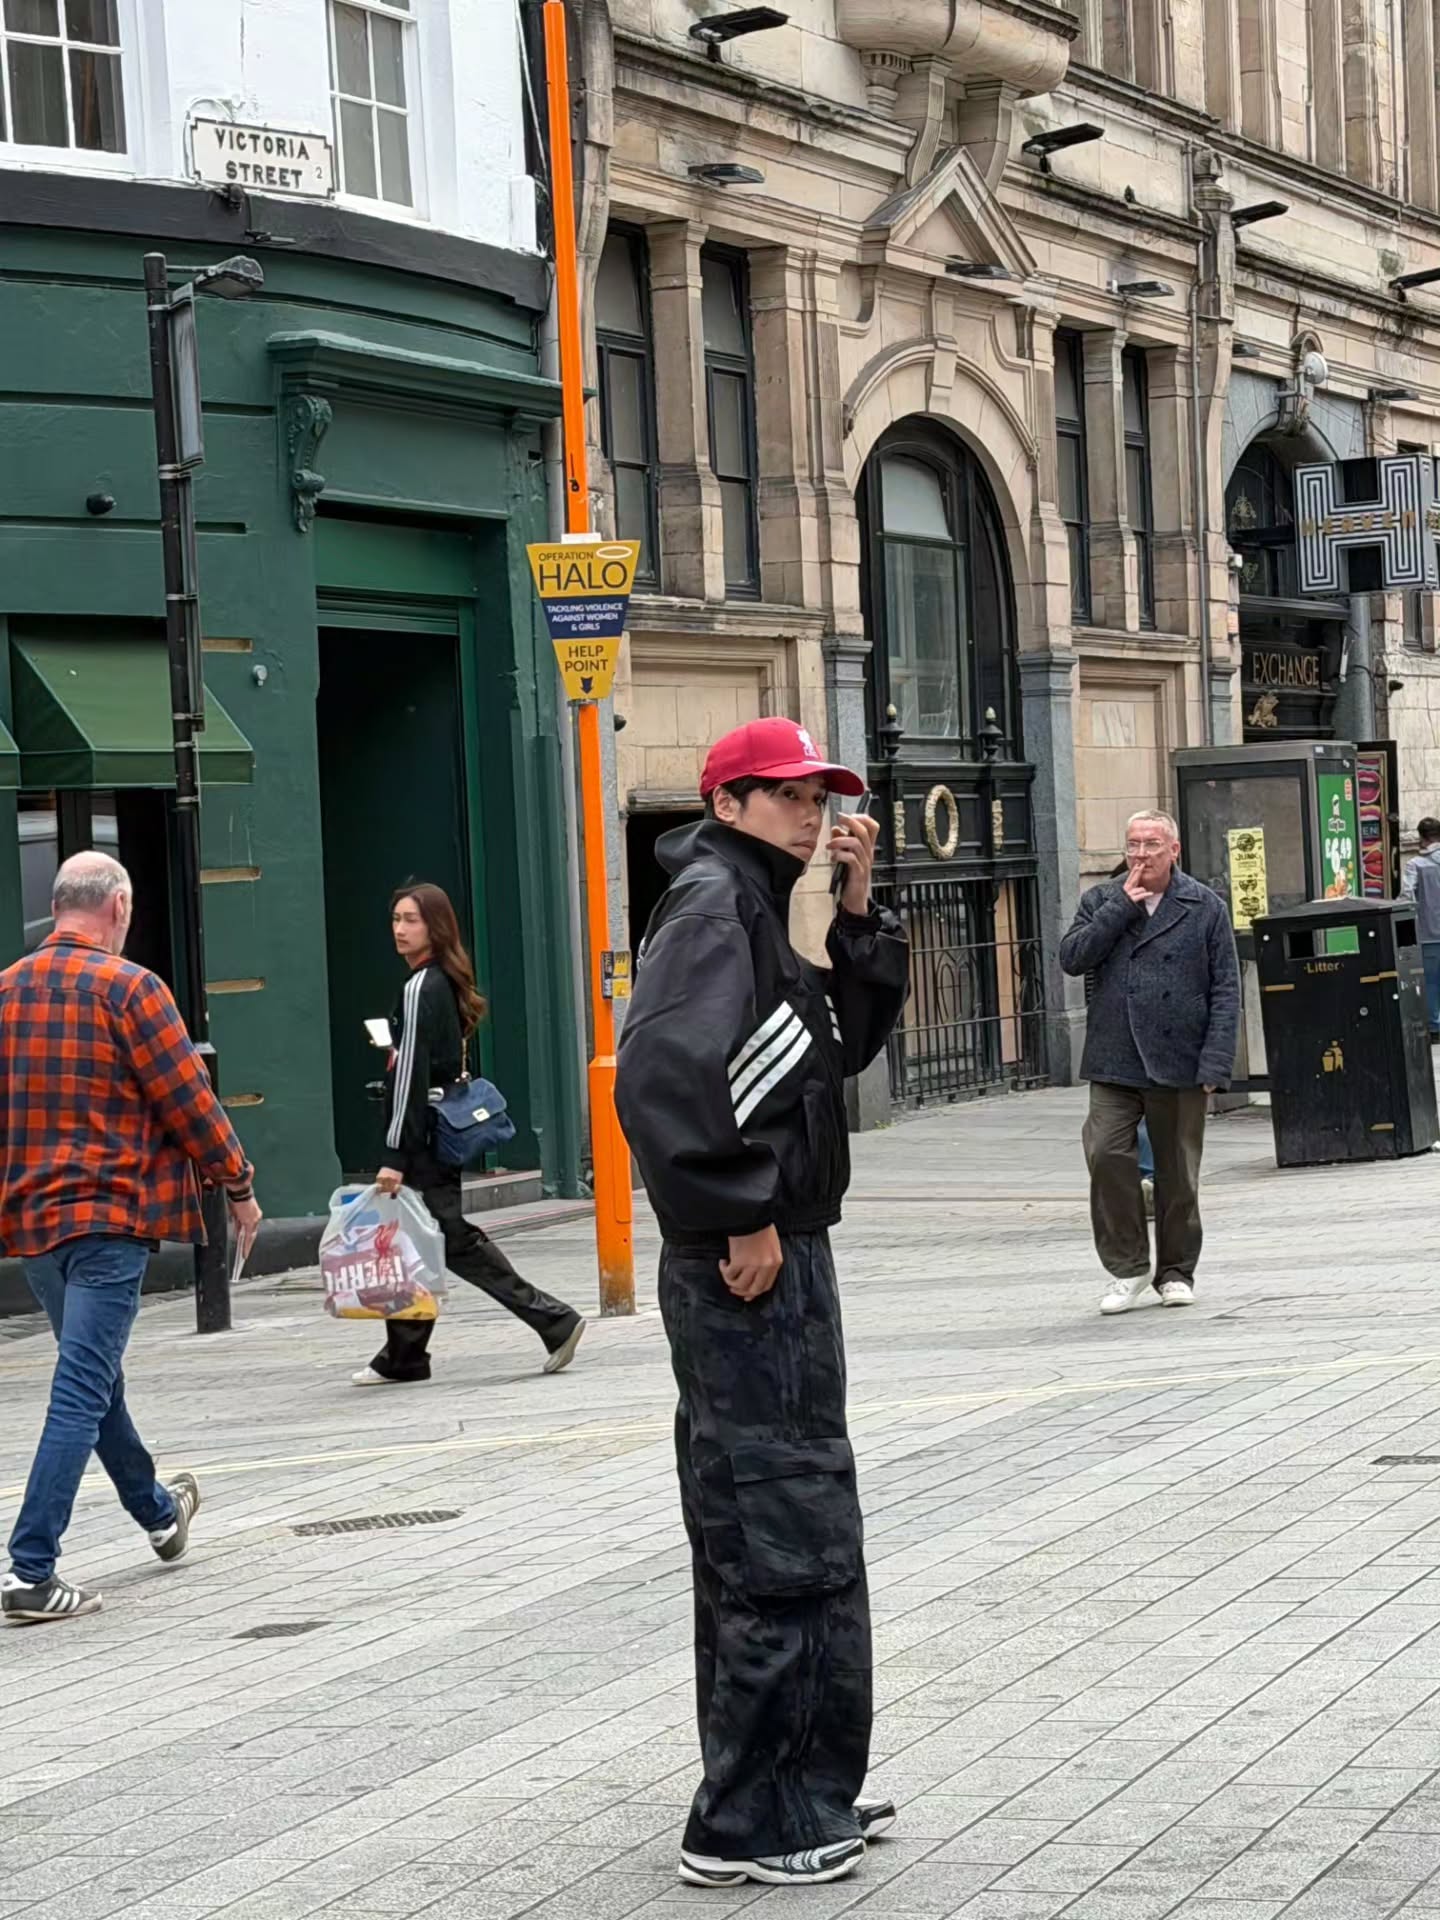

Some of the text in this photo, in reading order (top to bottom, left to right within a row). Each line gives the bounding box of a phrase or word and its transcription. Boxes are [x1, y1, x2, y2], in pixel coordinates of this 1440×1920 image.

[214, 127, 310, 161] VICTORIA
[225, 160, 323, 189] STREET 2
[538, 551, 594, 562] OPERATION
[539, 561, 628, 592] HALO
[546, 602, 623, 613] TACKLING VIOLENCE
[551, 612, 619, 623] AGAINST WOMEN
[571, 622, 600, 632] & GIRLS
[568, 645, 604, 658] HELP
[564, 659, 609, 673] POINT
[1252, 651, 1320, 687] EXCHANGE
[1306, 961, 1340, 974] Litter
